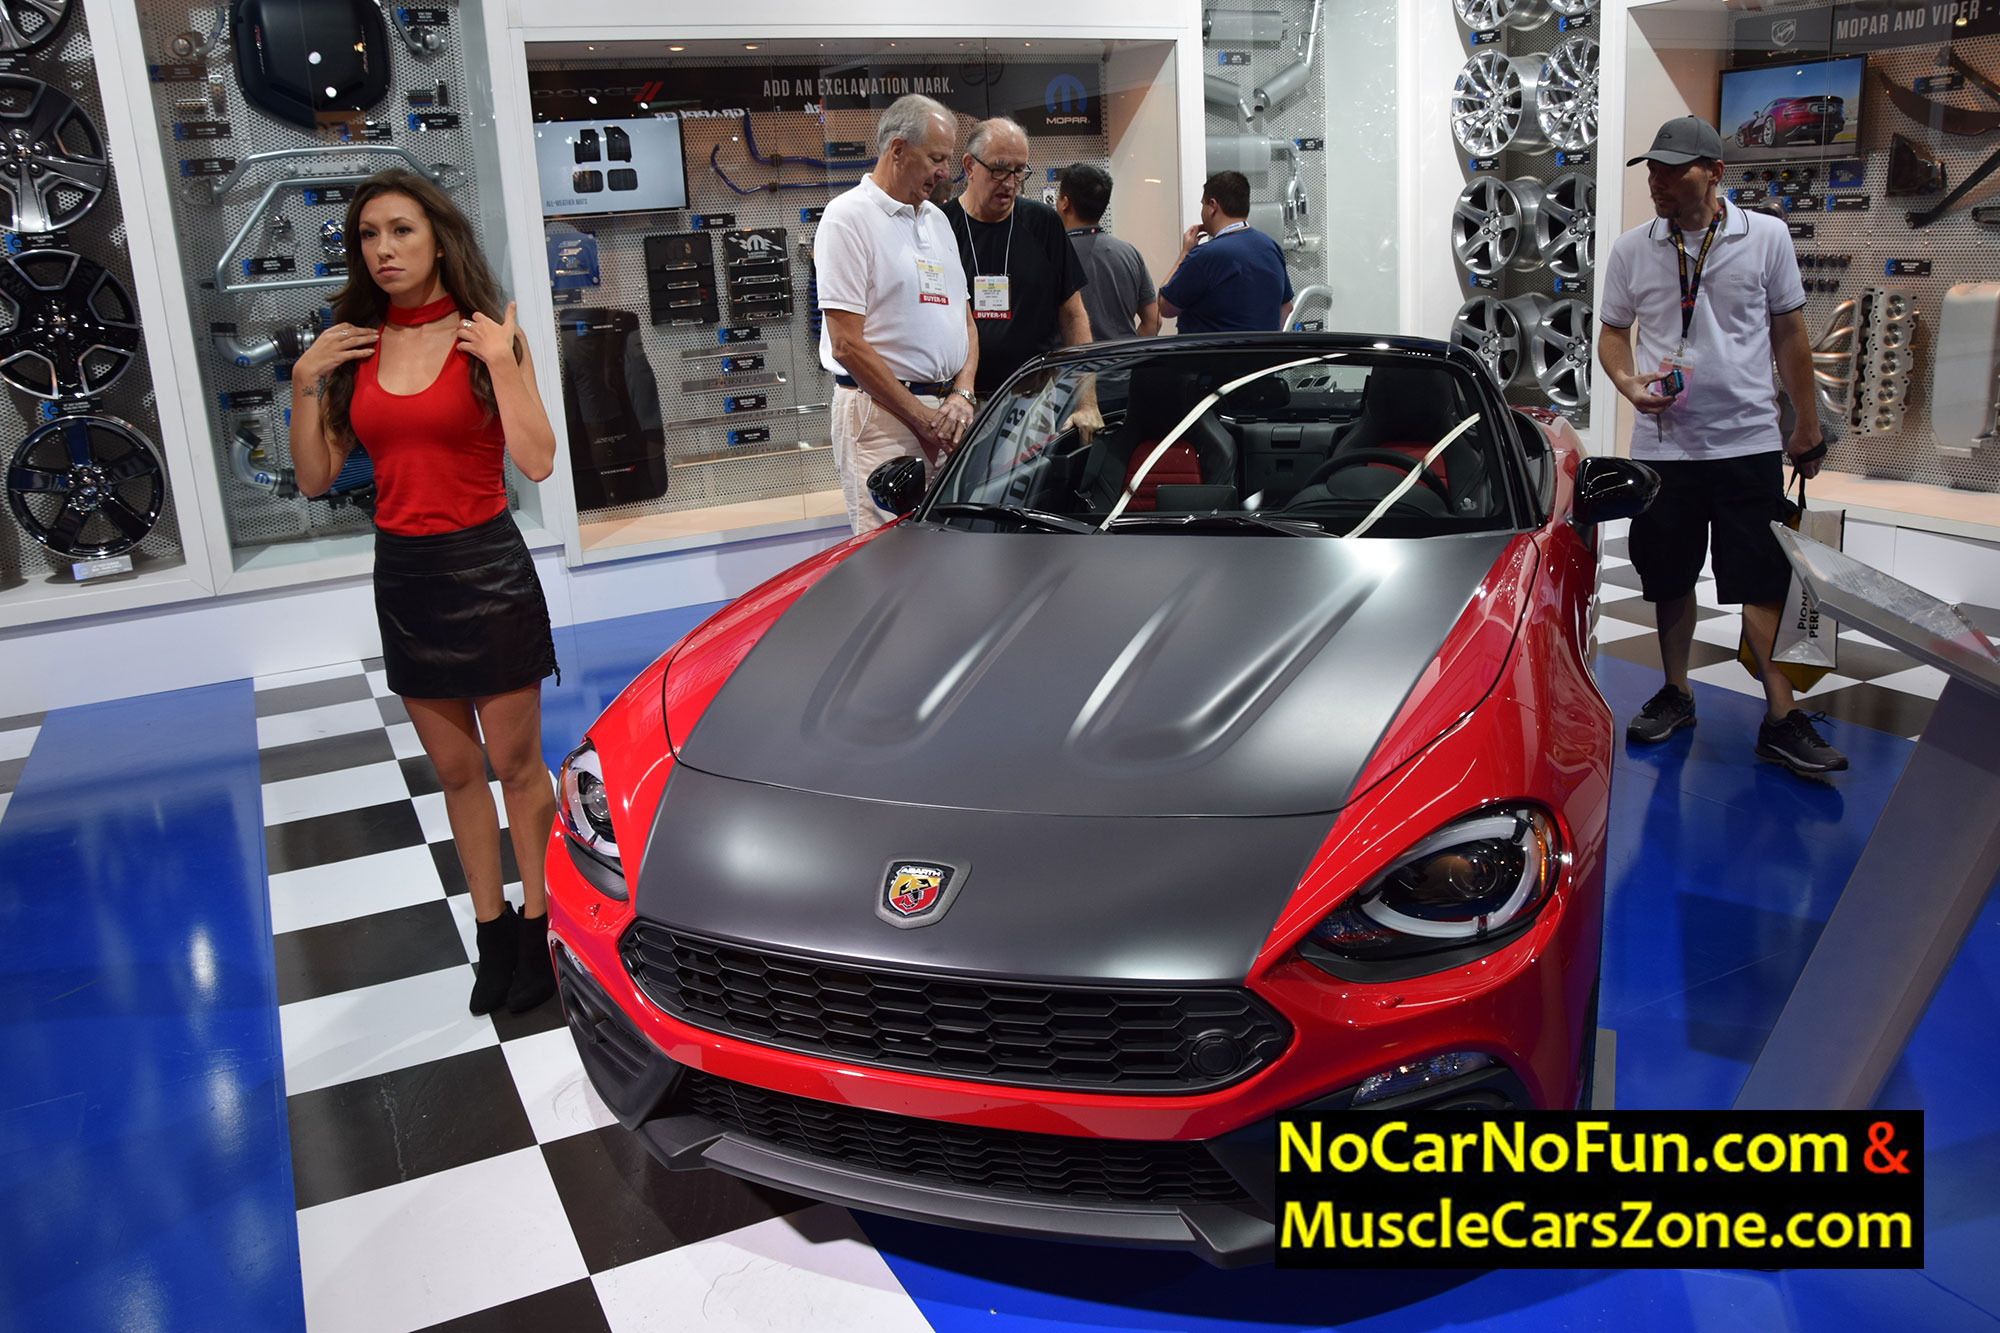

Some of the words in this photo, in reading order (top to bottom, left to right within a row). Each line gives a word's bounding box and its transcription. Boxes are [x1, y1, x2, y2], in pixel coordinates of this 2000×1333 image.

[1836, 13, 1889, 40] MOPAR
[1893, 8, 1926, 32] AND
[1932, 0, 1980, 26] VIPER
[532, 86, 645, 98] DODGE
[763, 80, 790, 97] ADD
[795, 79, 813, 97] AN
[818, 77, 910, 96] EXCLAMATION
[914, 76, 955, 94] MARK.
[1046, 116, 1088, 125] MOPAR
[901, 867, 941, 877] ABARTH
